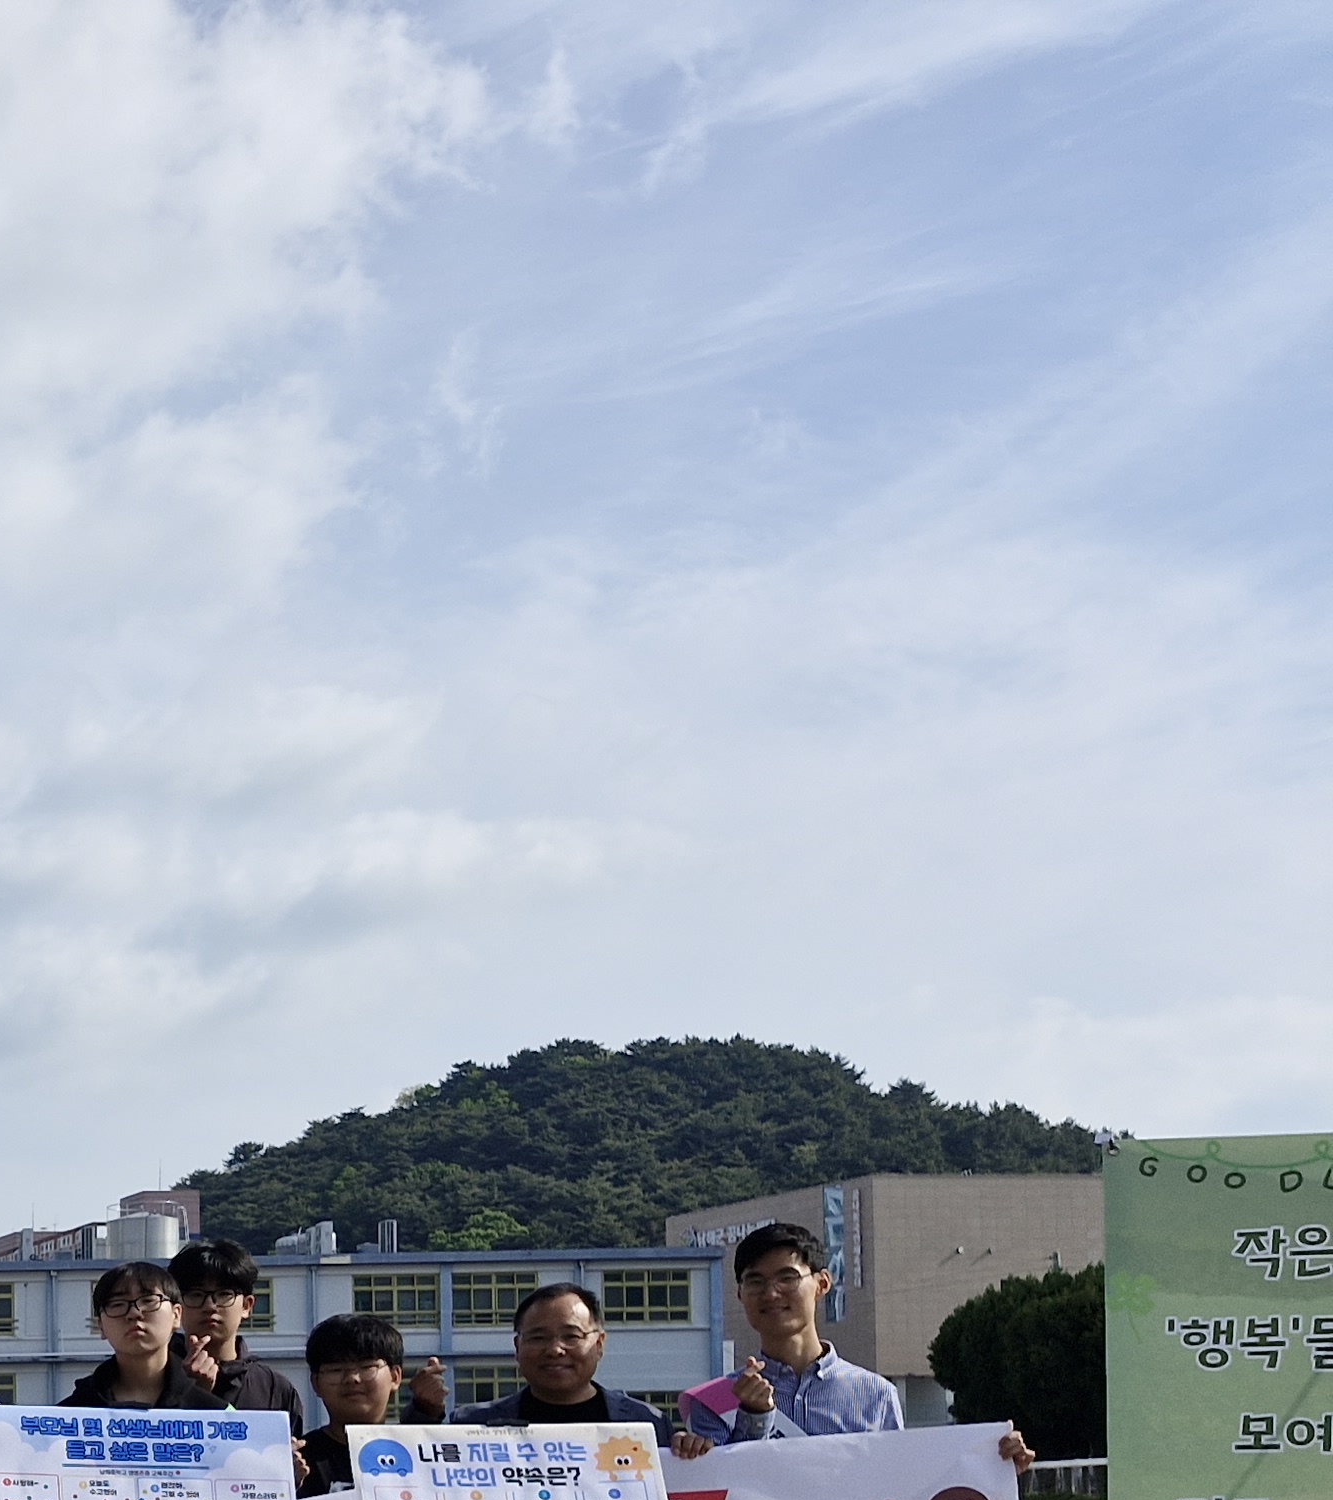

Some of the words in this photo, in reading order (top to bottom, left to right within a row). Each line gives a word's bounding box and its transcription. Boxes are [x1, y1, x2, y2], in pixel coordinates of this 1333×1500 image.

[1232, 1227, 1333, 1279] 작은
[20, 1415, 79, 1437] 부모님
[106, 1417, 205, 1440] 선생님에게
[1234, 1414, 1333, 1453] 모여
[65, 1439, 106, 1460] 듣고
[108, 1440, 149, 1462] 싶은
[151, 1442, 205, 1463] 말은?
[417, 1443, 462, 1463] 나를
[466, 1442, 512, 1463] 지킬
[516, 1442, 539, 1462] 수
[543, 1441, 587, 1462] 있는
[431, 1466, 497, 1488] 나만의
[502, 1466, 582, 1487] 약속은?
